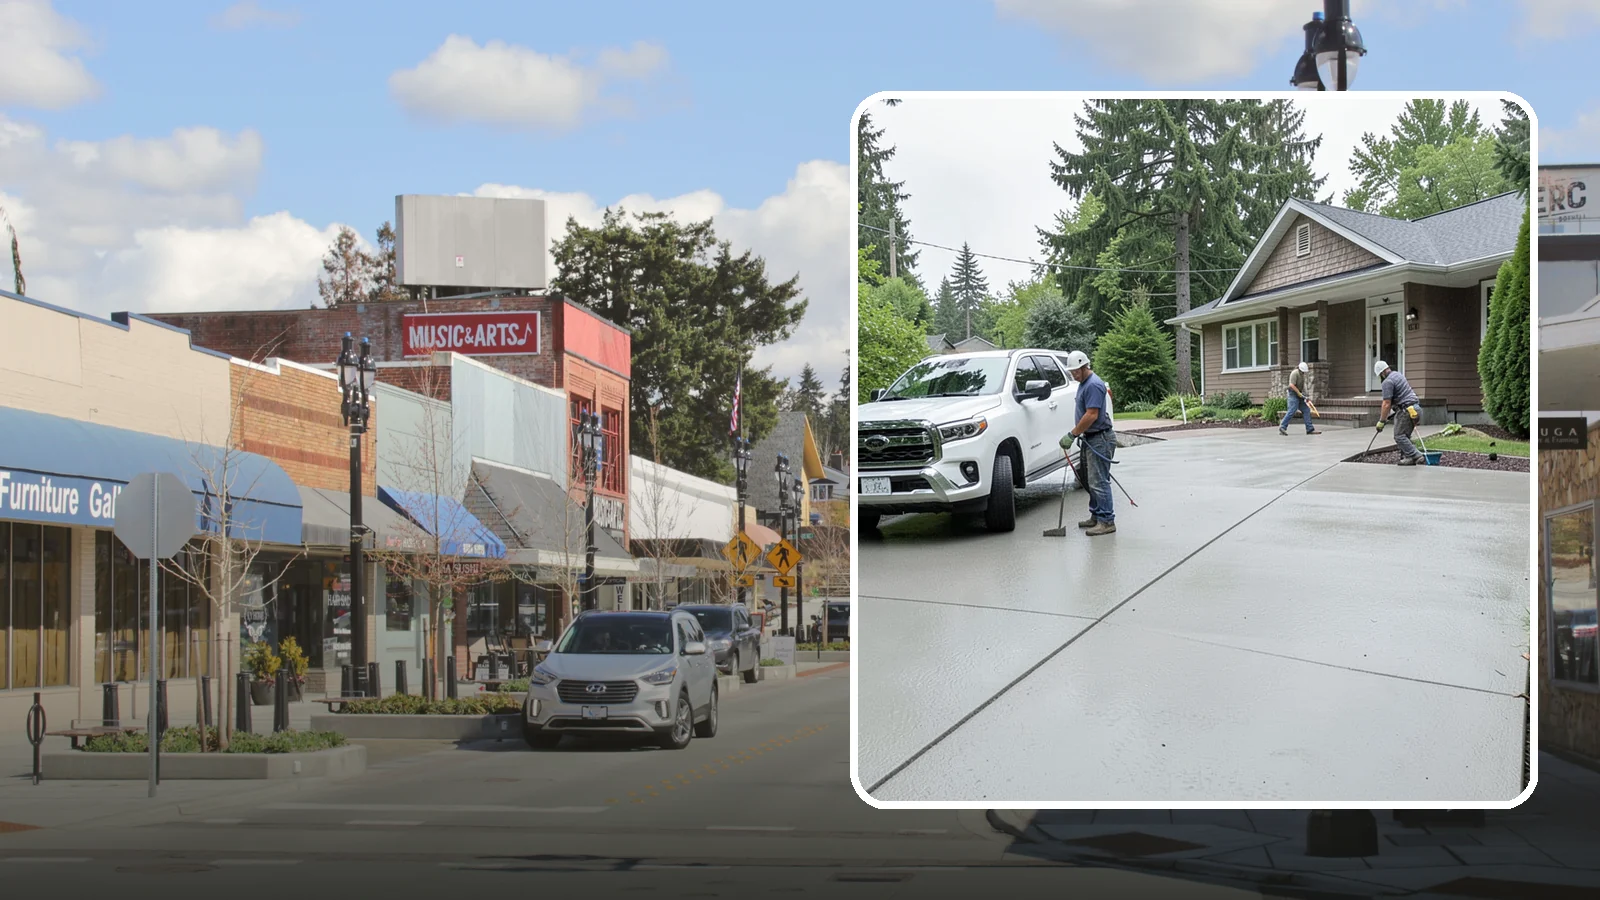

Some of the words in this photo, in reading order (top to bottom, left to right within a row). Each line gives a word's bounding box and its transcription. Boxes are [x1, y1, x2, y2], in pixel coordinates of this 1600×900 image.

[1540, 427, 1577, 436] UGA
[0, 472, 79, 515] Furniture
[453, 562, 479, 574] SUSHI
